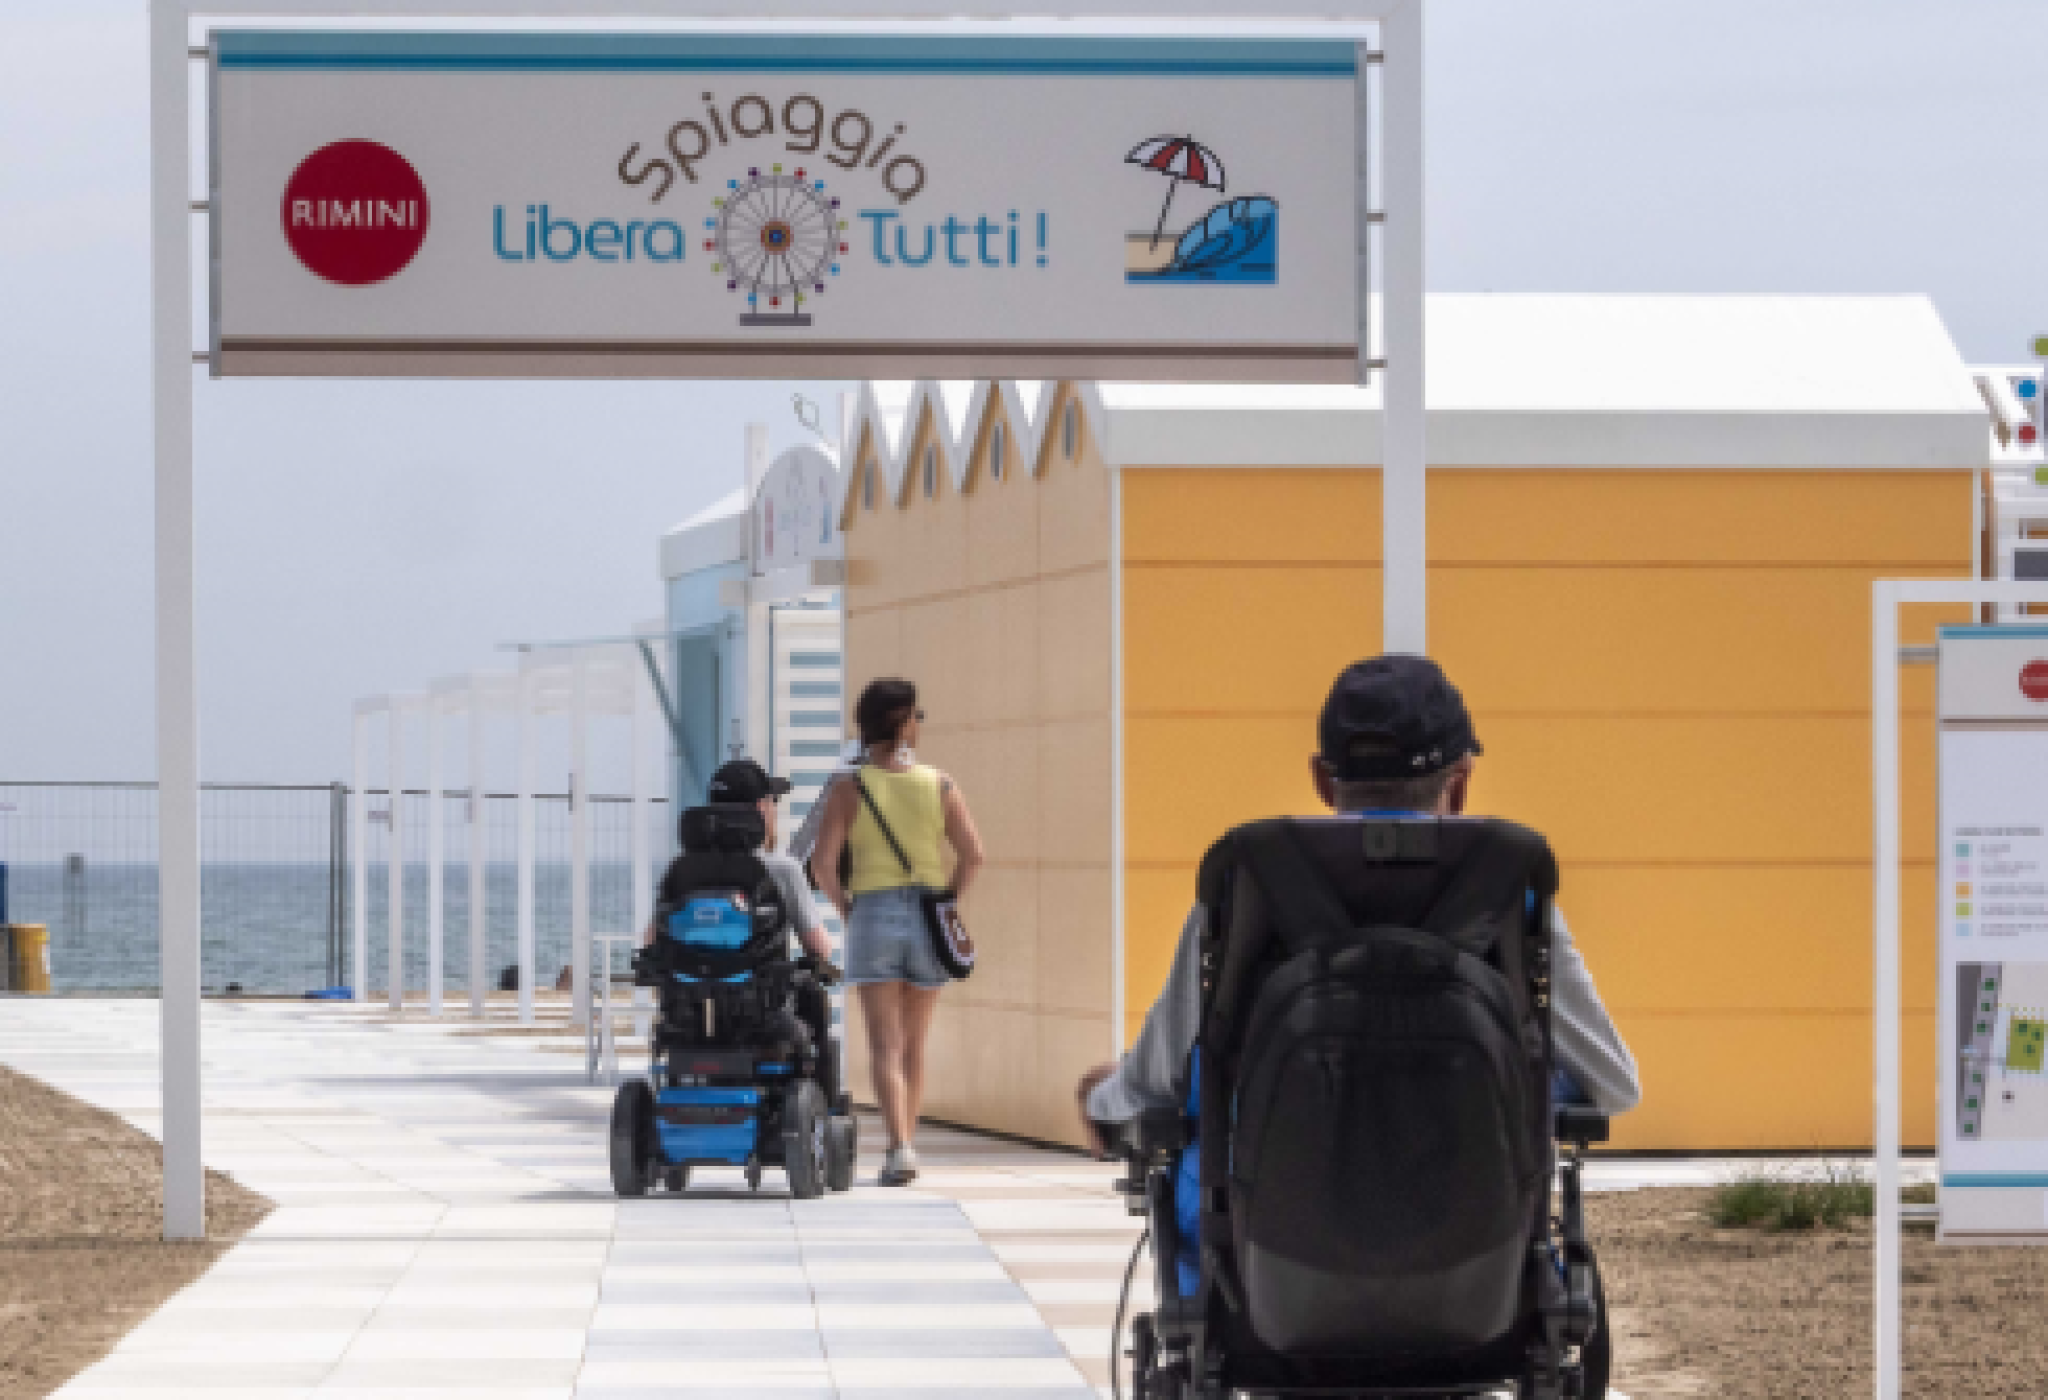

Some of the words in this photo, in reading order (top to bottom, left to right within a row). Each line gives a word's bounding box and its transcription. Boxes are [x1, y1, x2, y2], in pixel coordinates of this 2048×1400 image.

[617, 91, 927, 203] Spiaggia
[291, 198, 418, 228] RIMINI
[492, 204, 686, 263] Libera
